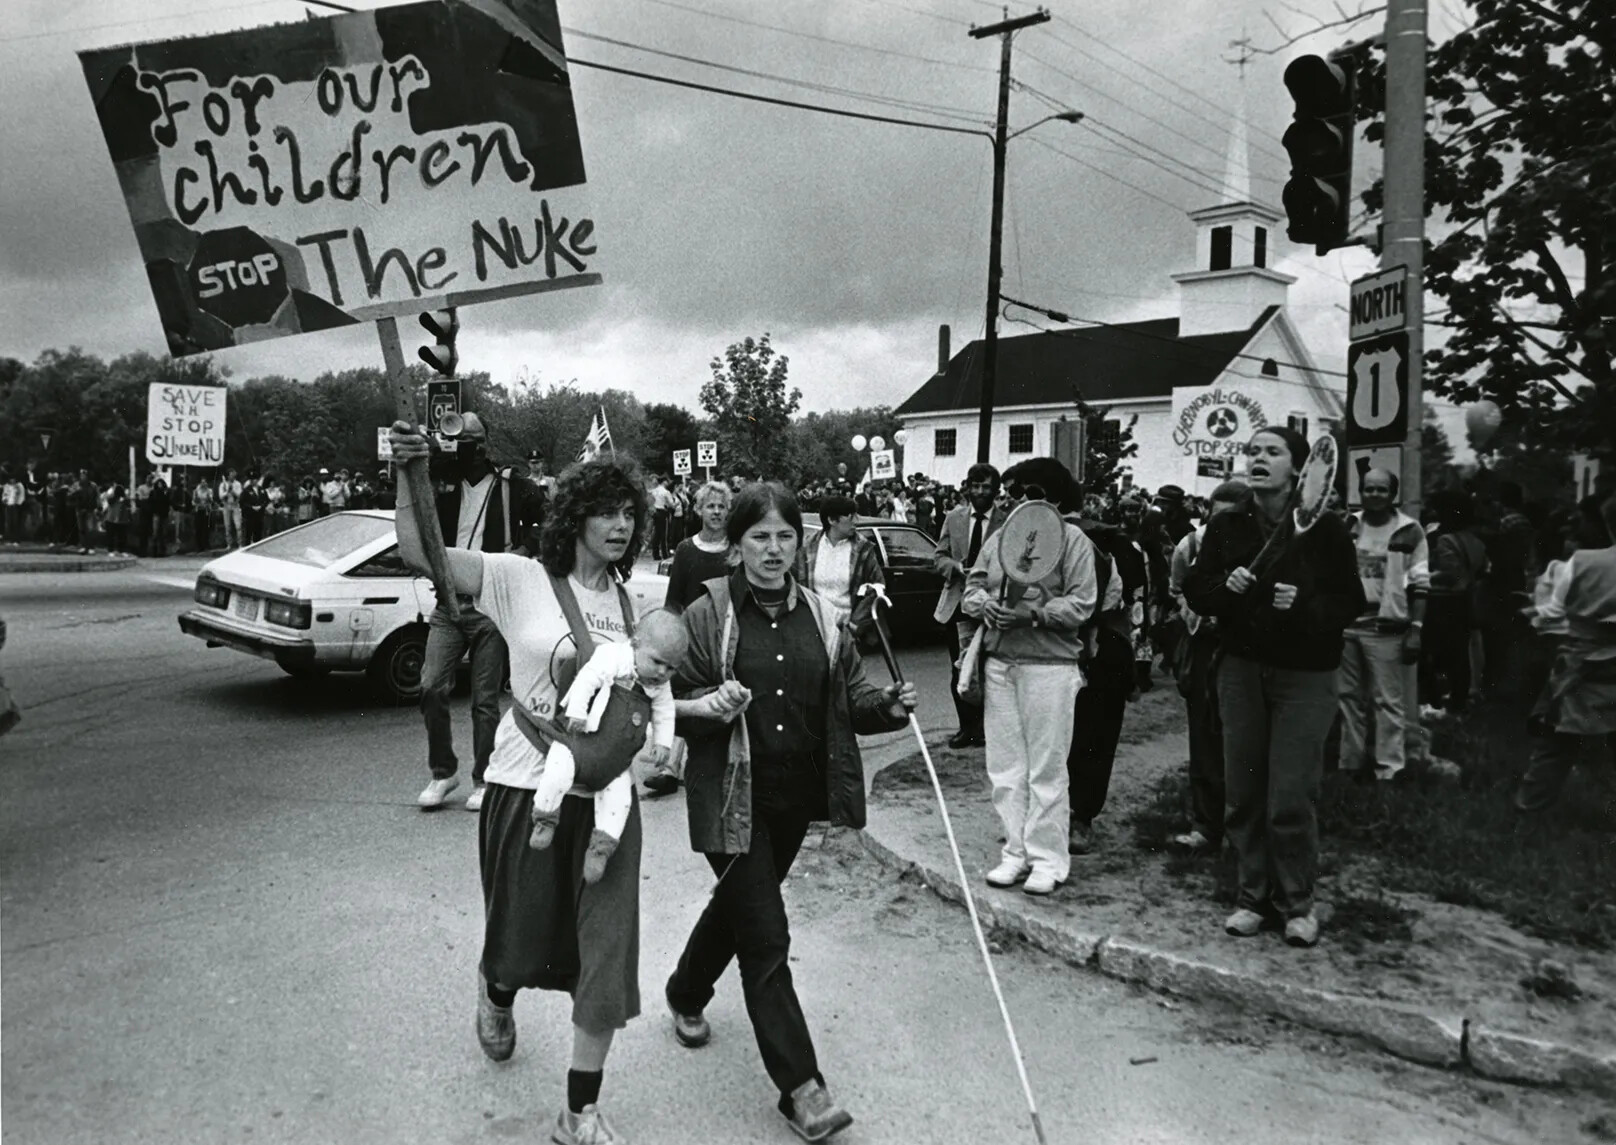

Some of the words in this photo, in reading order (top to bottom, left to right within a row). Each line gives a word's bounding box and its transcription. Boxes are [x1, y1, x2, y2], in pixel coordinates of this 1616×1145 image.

[140, 71, 275, 148] For
[317, 59, 424, 117] our
[174, 119, 531, 225] children
[199, 252, 279, 299] STOP
[295, 226, 459, 306] The
[471, 199, 598, 282] Nuke
[1351, 279, 1405, 327] NORTH
[162, 386, 216, 407] SAVE
[1370, 361, 1381, 418] 1
[162, 417, 214, 435] STOP
[1183, 439, 1221, 457] STOP
